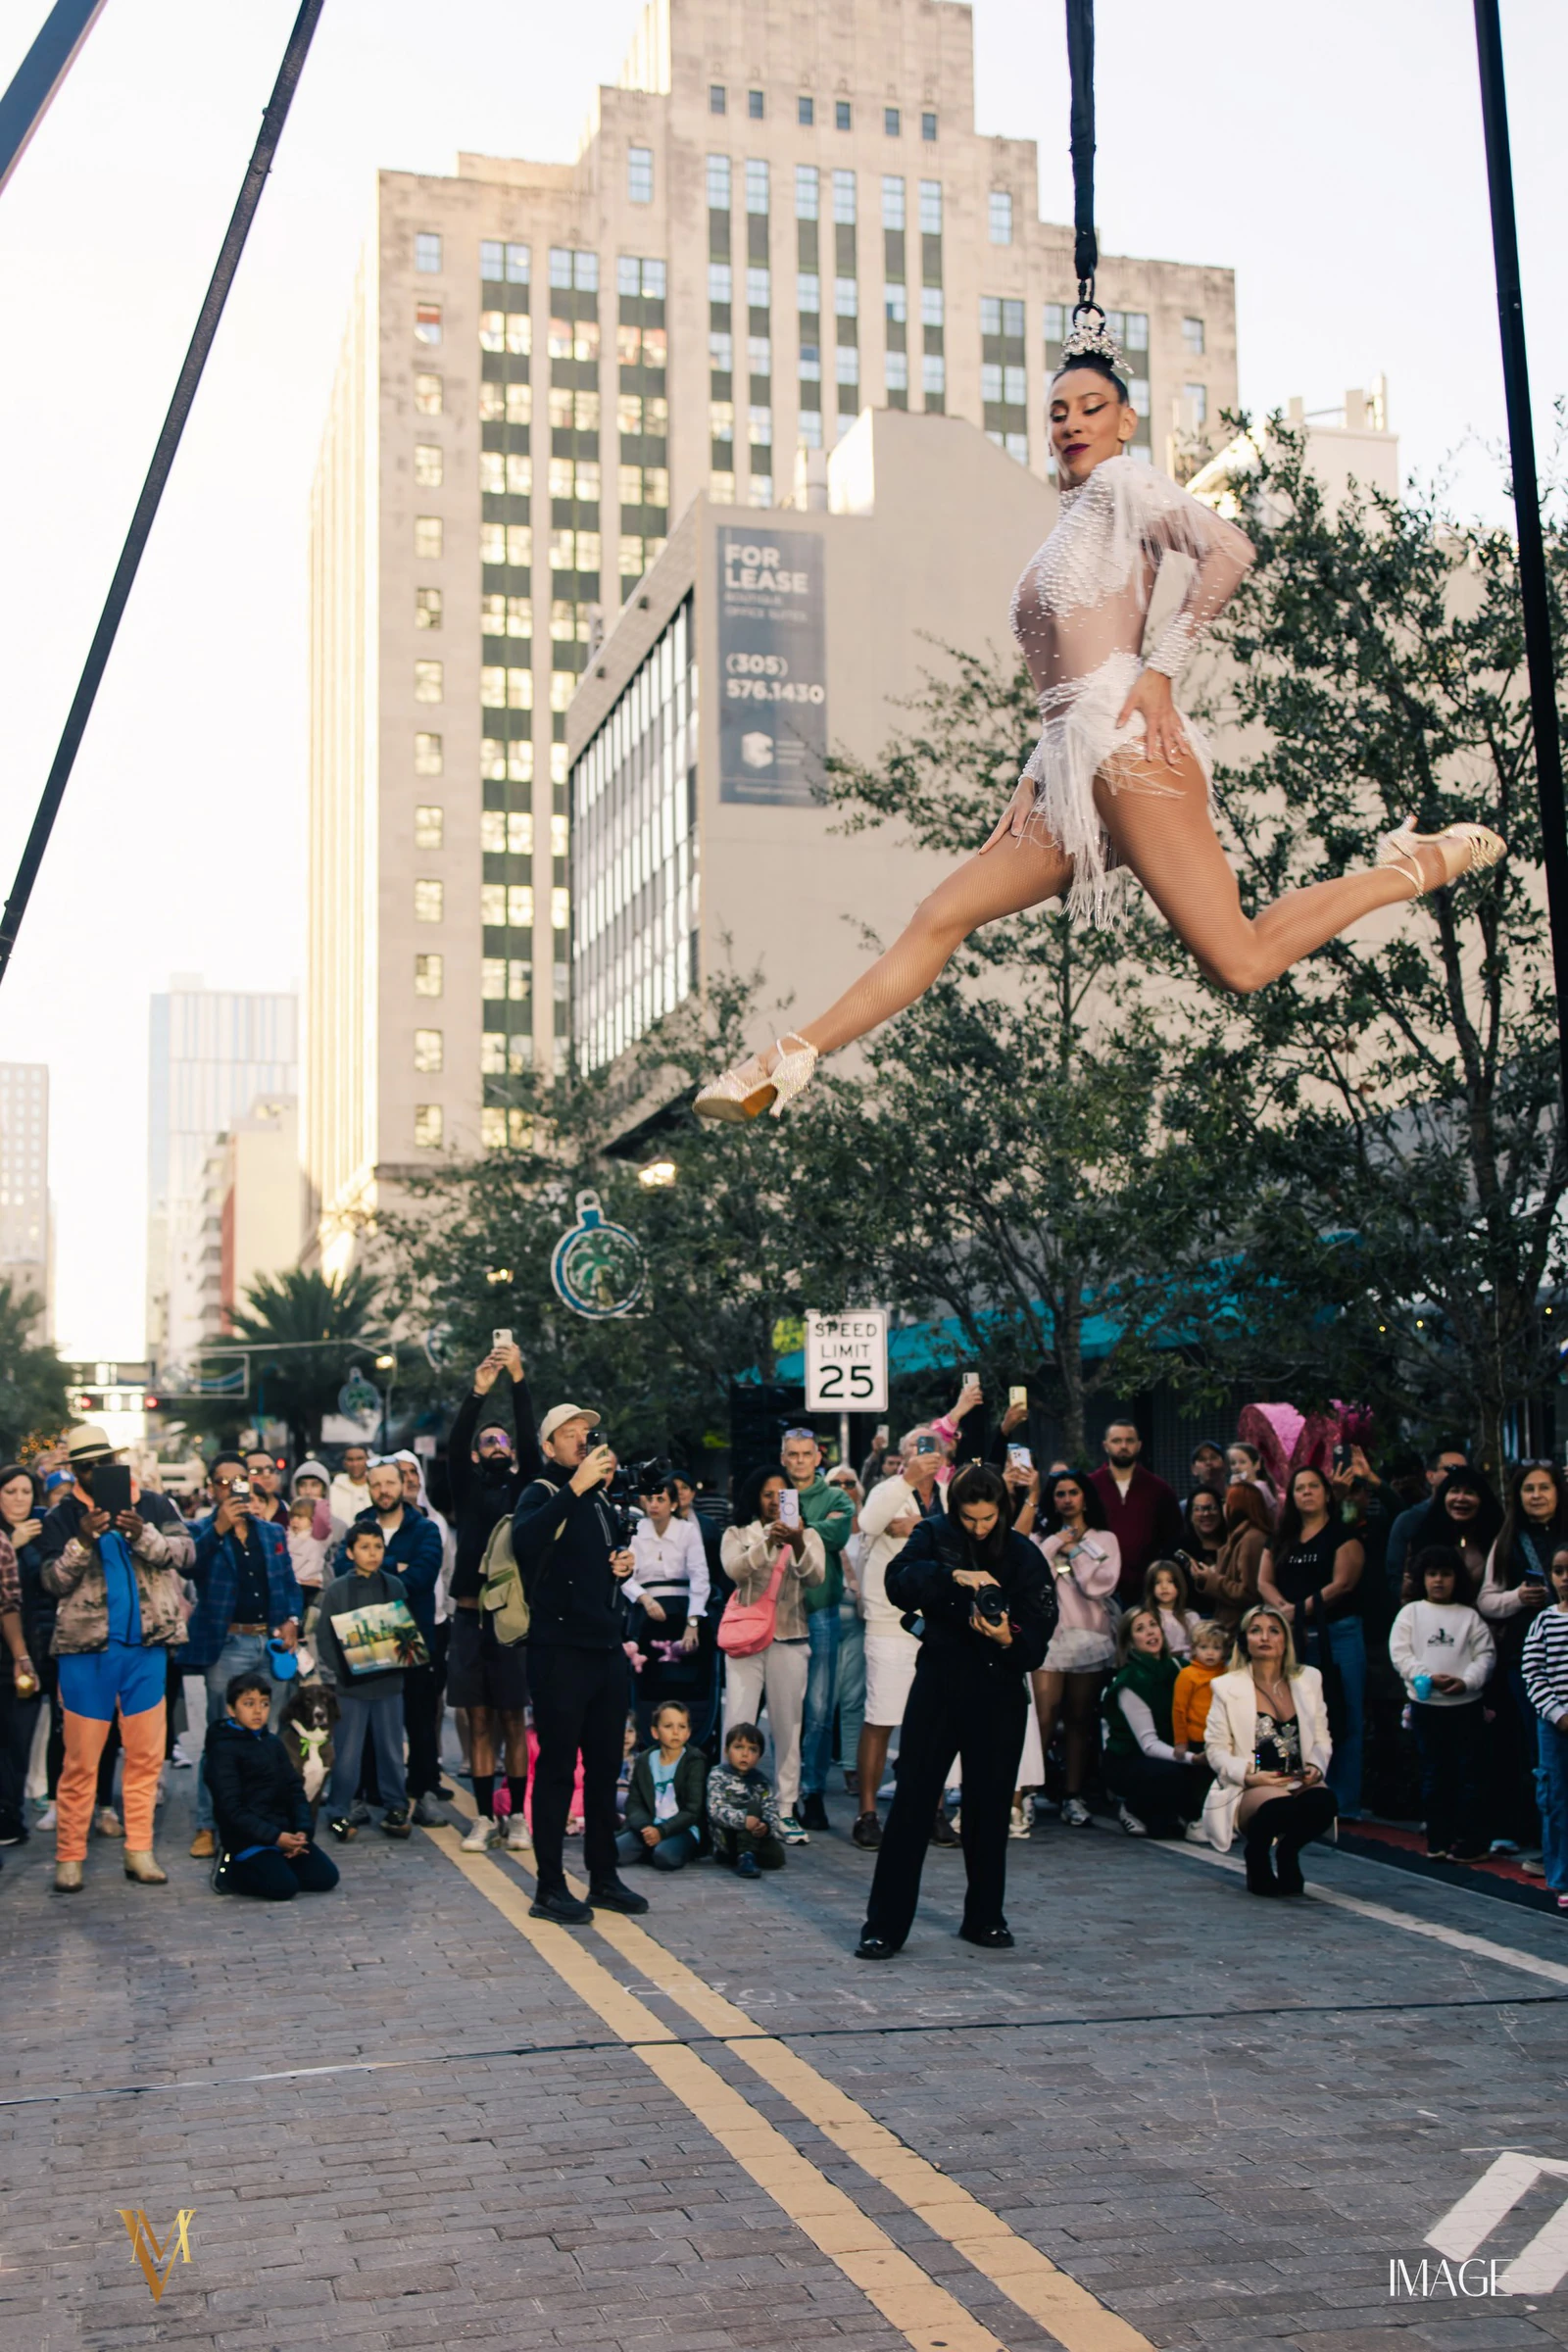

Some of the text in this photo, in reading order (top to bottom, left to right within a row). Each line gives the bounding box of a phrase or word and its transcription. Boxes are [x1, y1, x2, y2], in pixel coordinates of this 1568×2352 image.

[725, 544, 780, 568] FOR
[725, 568, 808, 594] LEASE
[725, 653, 788, 677] (305)
[726, 679, 825, 706] 576.1430
[815, 1323, 877, 1338] SPEED
[821, 1345, 870, 1358] LIMIT
[819, 1365, 874, 1398] 25
